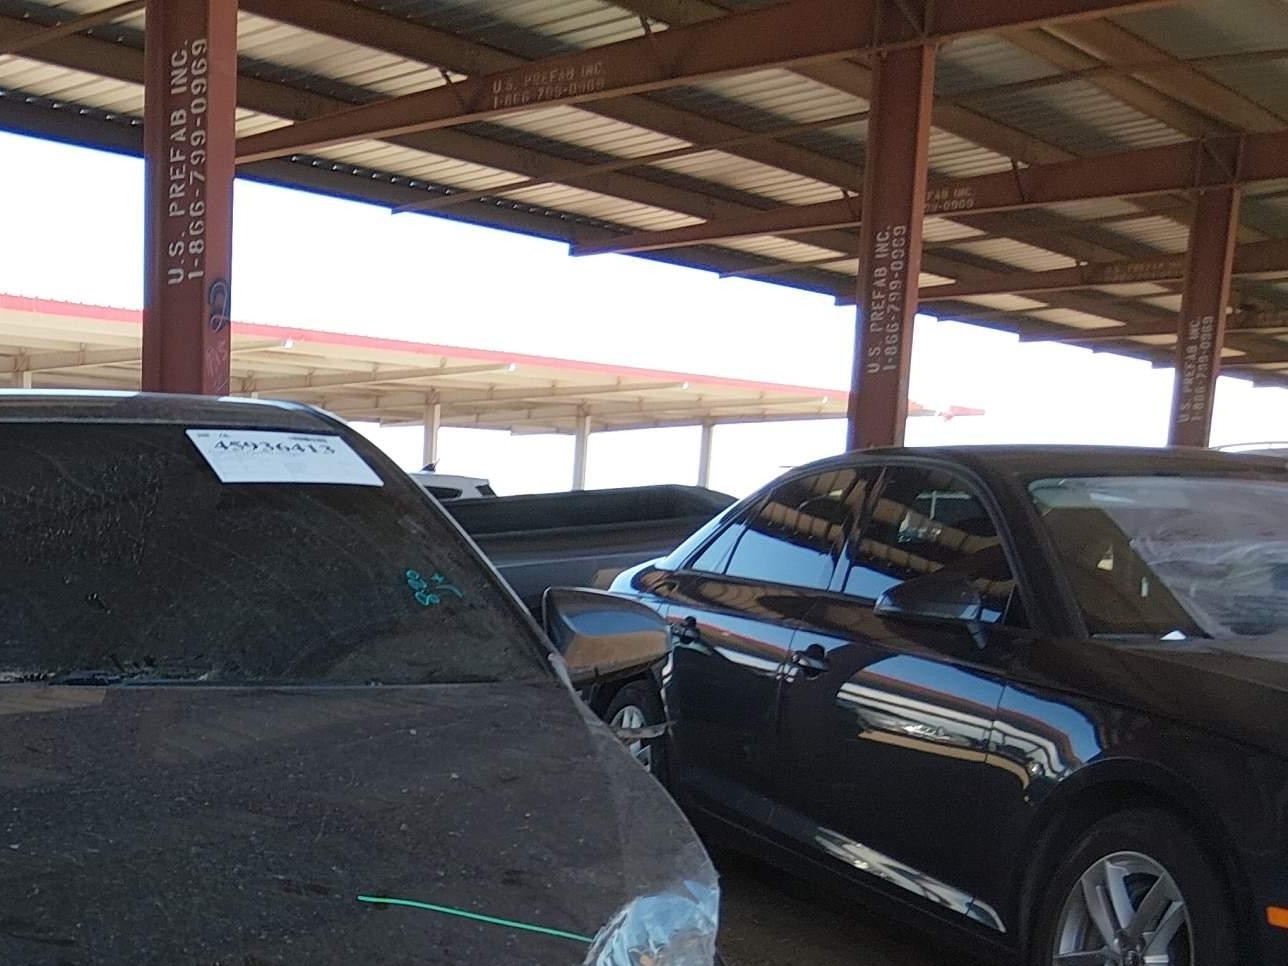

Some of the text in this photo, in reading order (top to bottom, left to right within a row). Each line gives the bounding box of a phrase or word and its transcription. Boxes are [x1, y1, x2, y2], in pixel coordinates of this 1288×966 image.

[168, 40, 189, 285] U.S. PREFAB INC.
[188, 38, 208, 280] 1-866-799-0969
[867, 226, 891, 374] U.S. PREFAB INC.
[883, 225, 907, 371] 1-866-799-0969
